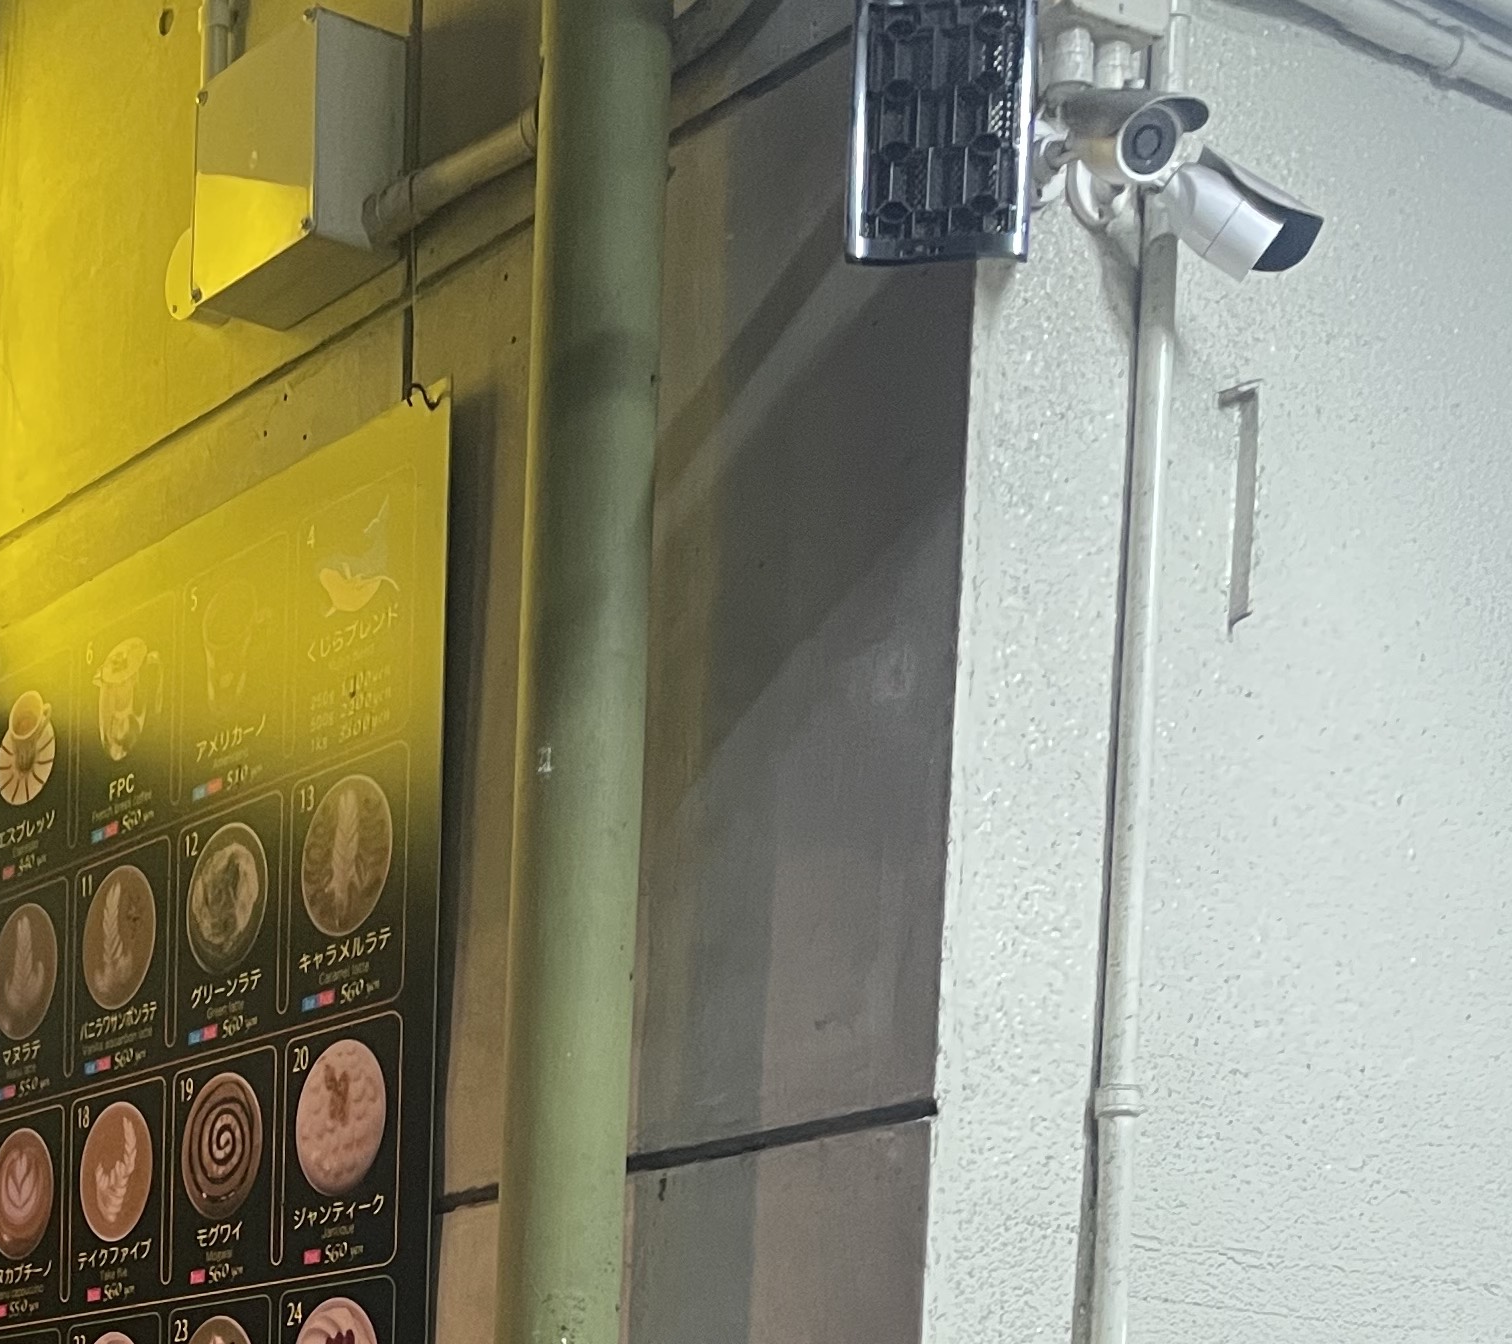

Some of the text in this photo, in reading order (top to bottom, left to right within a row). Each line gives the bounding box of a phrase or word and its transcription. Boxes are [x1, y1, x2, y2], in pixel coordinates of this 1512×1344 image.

[306, 525, 317, 549] 4
[190, 587, 198, 612] 5
[196, 713, 266, 763] アメリカーノ
[109, 773, 135, 801] FPC
[300, 785, 315, 813] 13
[185, 832, 199, 858] 12
[82, 874, 93, 898] 11
[299, 926, 392, 974] キャラメルラテ
[191, 968, 263, 1009] グリーンラテ
[340, 979, 365, 1005] 560
[2, 1040, 41, 1066] マヌラテ
[292, 1045, 309, 1073] 20
[179, 1077, 194, 1102] 19
[77, 1105, 90, 1129] 18
[196, 1221, 243, 1248] モグワイ
[324, 1240, 348, 1265] 560
[286, 1301, 303, 1327] 24
[174, 1318, 188, 1343] 23
